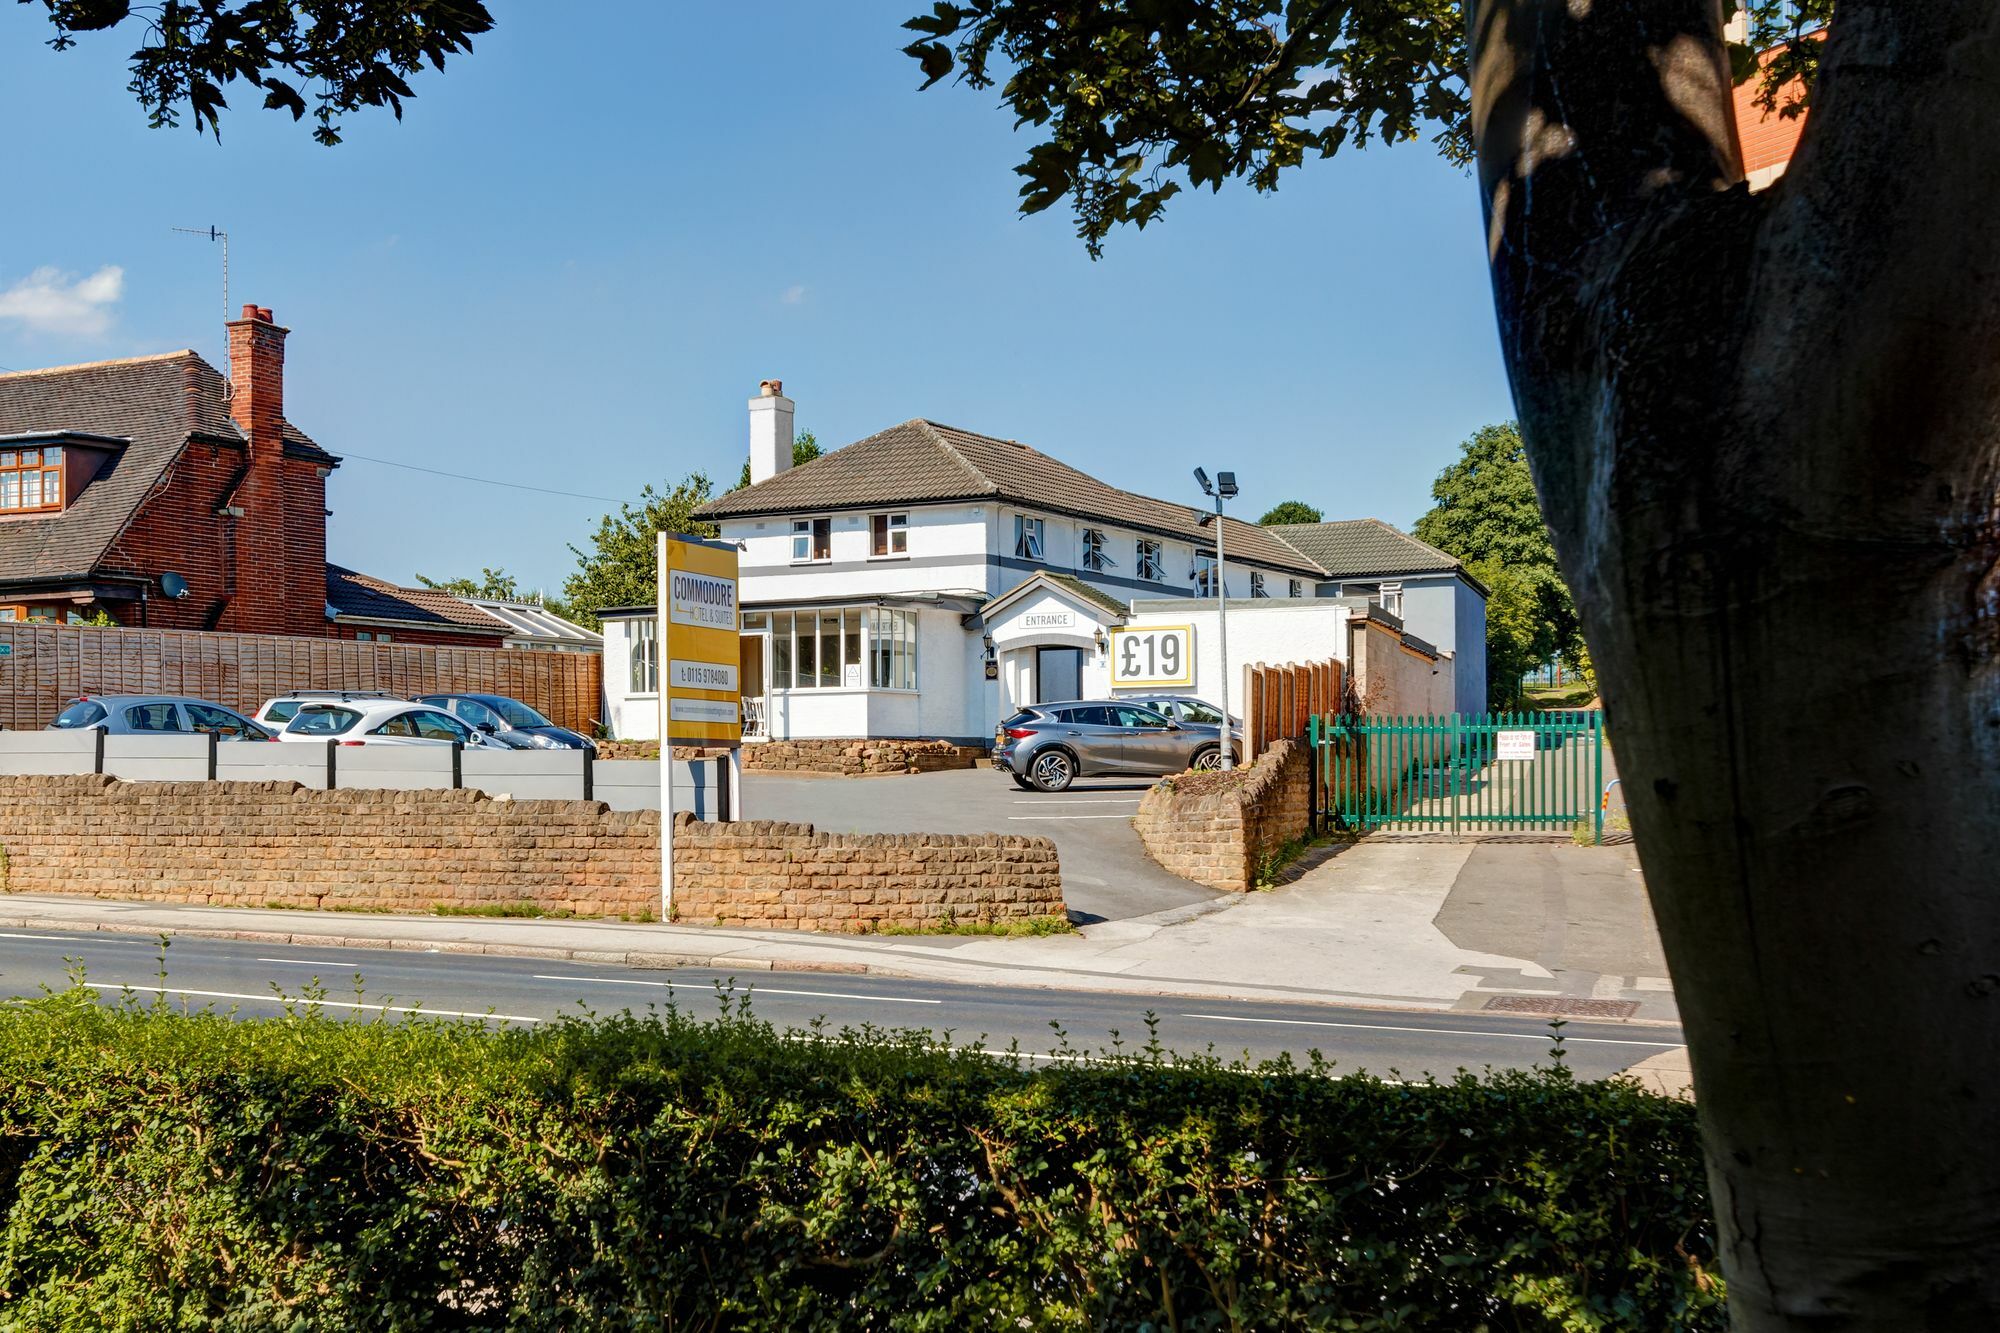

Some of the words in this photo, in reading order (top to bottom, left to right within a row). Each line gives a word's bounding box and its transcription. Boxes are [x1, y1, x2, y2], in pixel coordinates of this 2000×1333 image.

[674, 575, 733, 608] COMMODORE
[689, 605, 708, 622] HOTEL
[709, 608, 714, 622] &
[715, 609, 733, 625] SUITES
[1025, 614, 1068, 626] ENTRANCE
[1121, 634, 1180, 677] £19
[687, 667, 702, 683] 0115
[703, 668, 729, 685] 9784080
